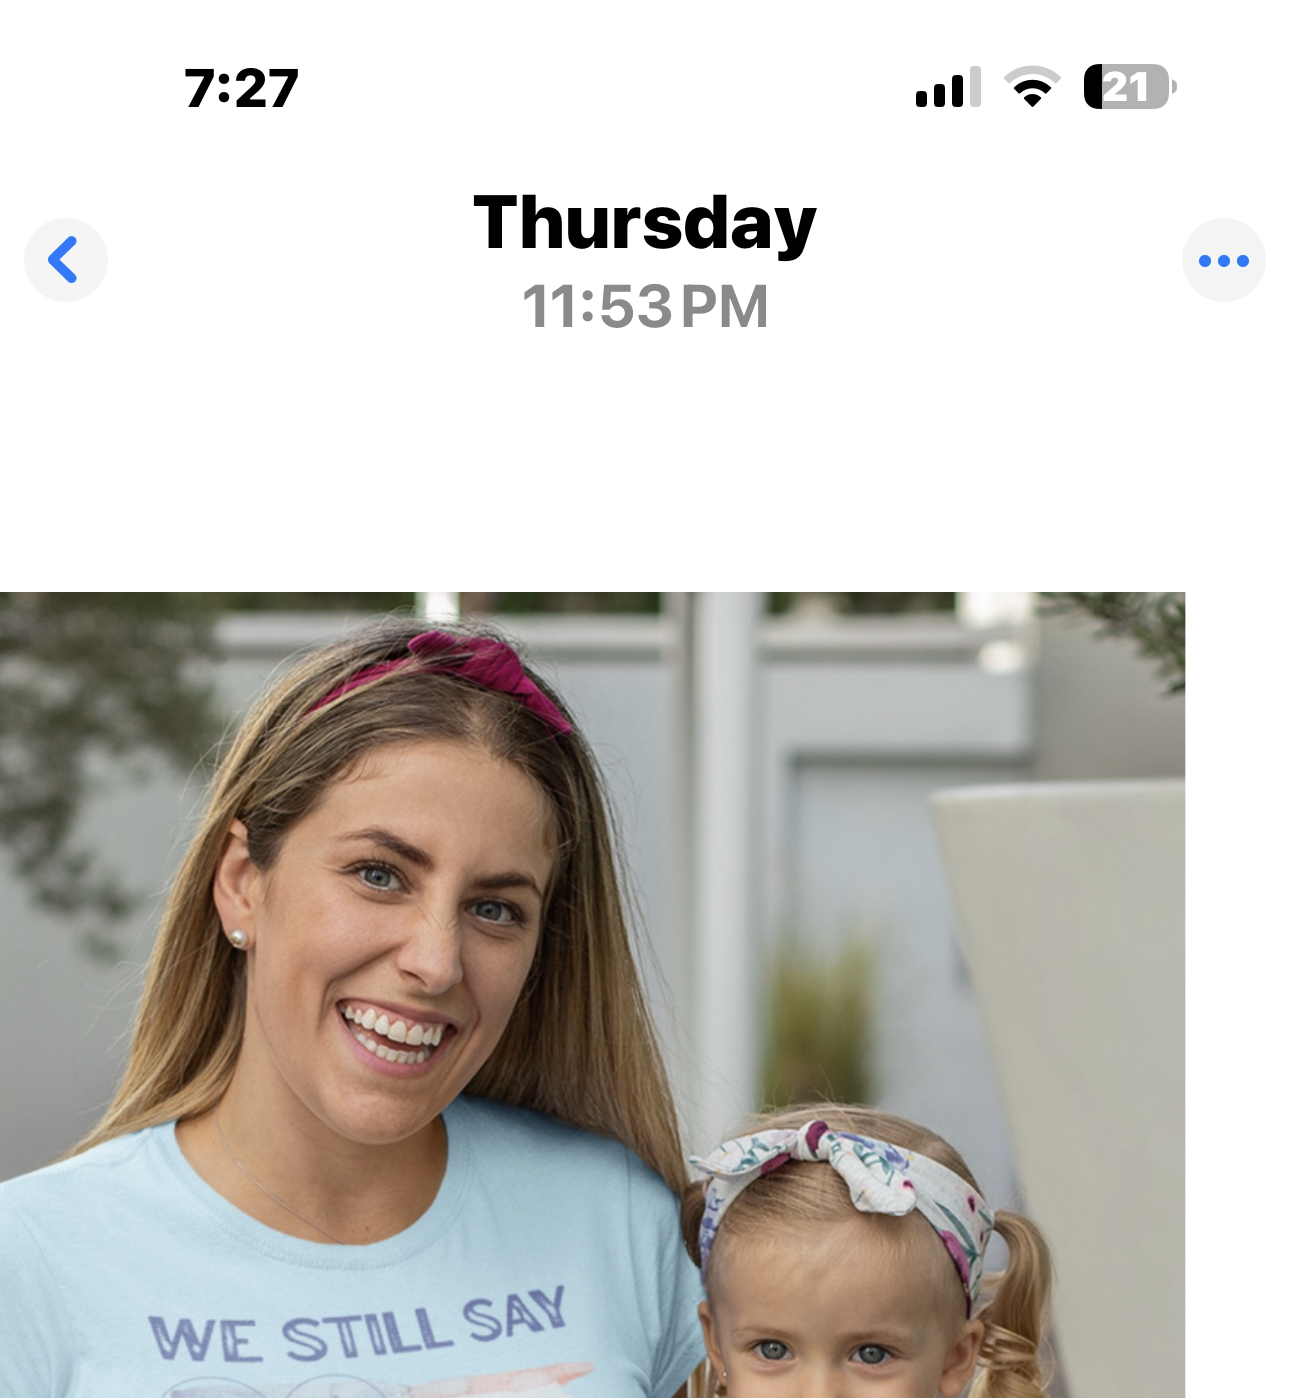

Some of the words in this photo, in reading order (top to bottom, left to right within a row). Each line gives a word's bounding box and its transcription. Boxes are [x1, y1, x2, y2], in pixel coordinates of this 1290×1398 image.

[184, 67, 299, 108] 7:27
[1102, 71, 1148, 102] 21
[473, 193, 818, 262] Thursday
[523, 283, 672, 329] 11:53
[683, 283, 768, 328] PM
[148, 1315, 263, 1363] WE
[282, 1308, 455, 1363] STILL
[463, 1286, 567, 1342] SAY
